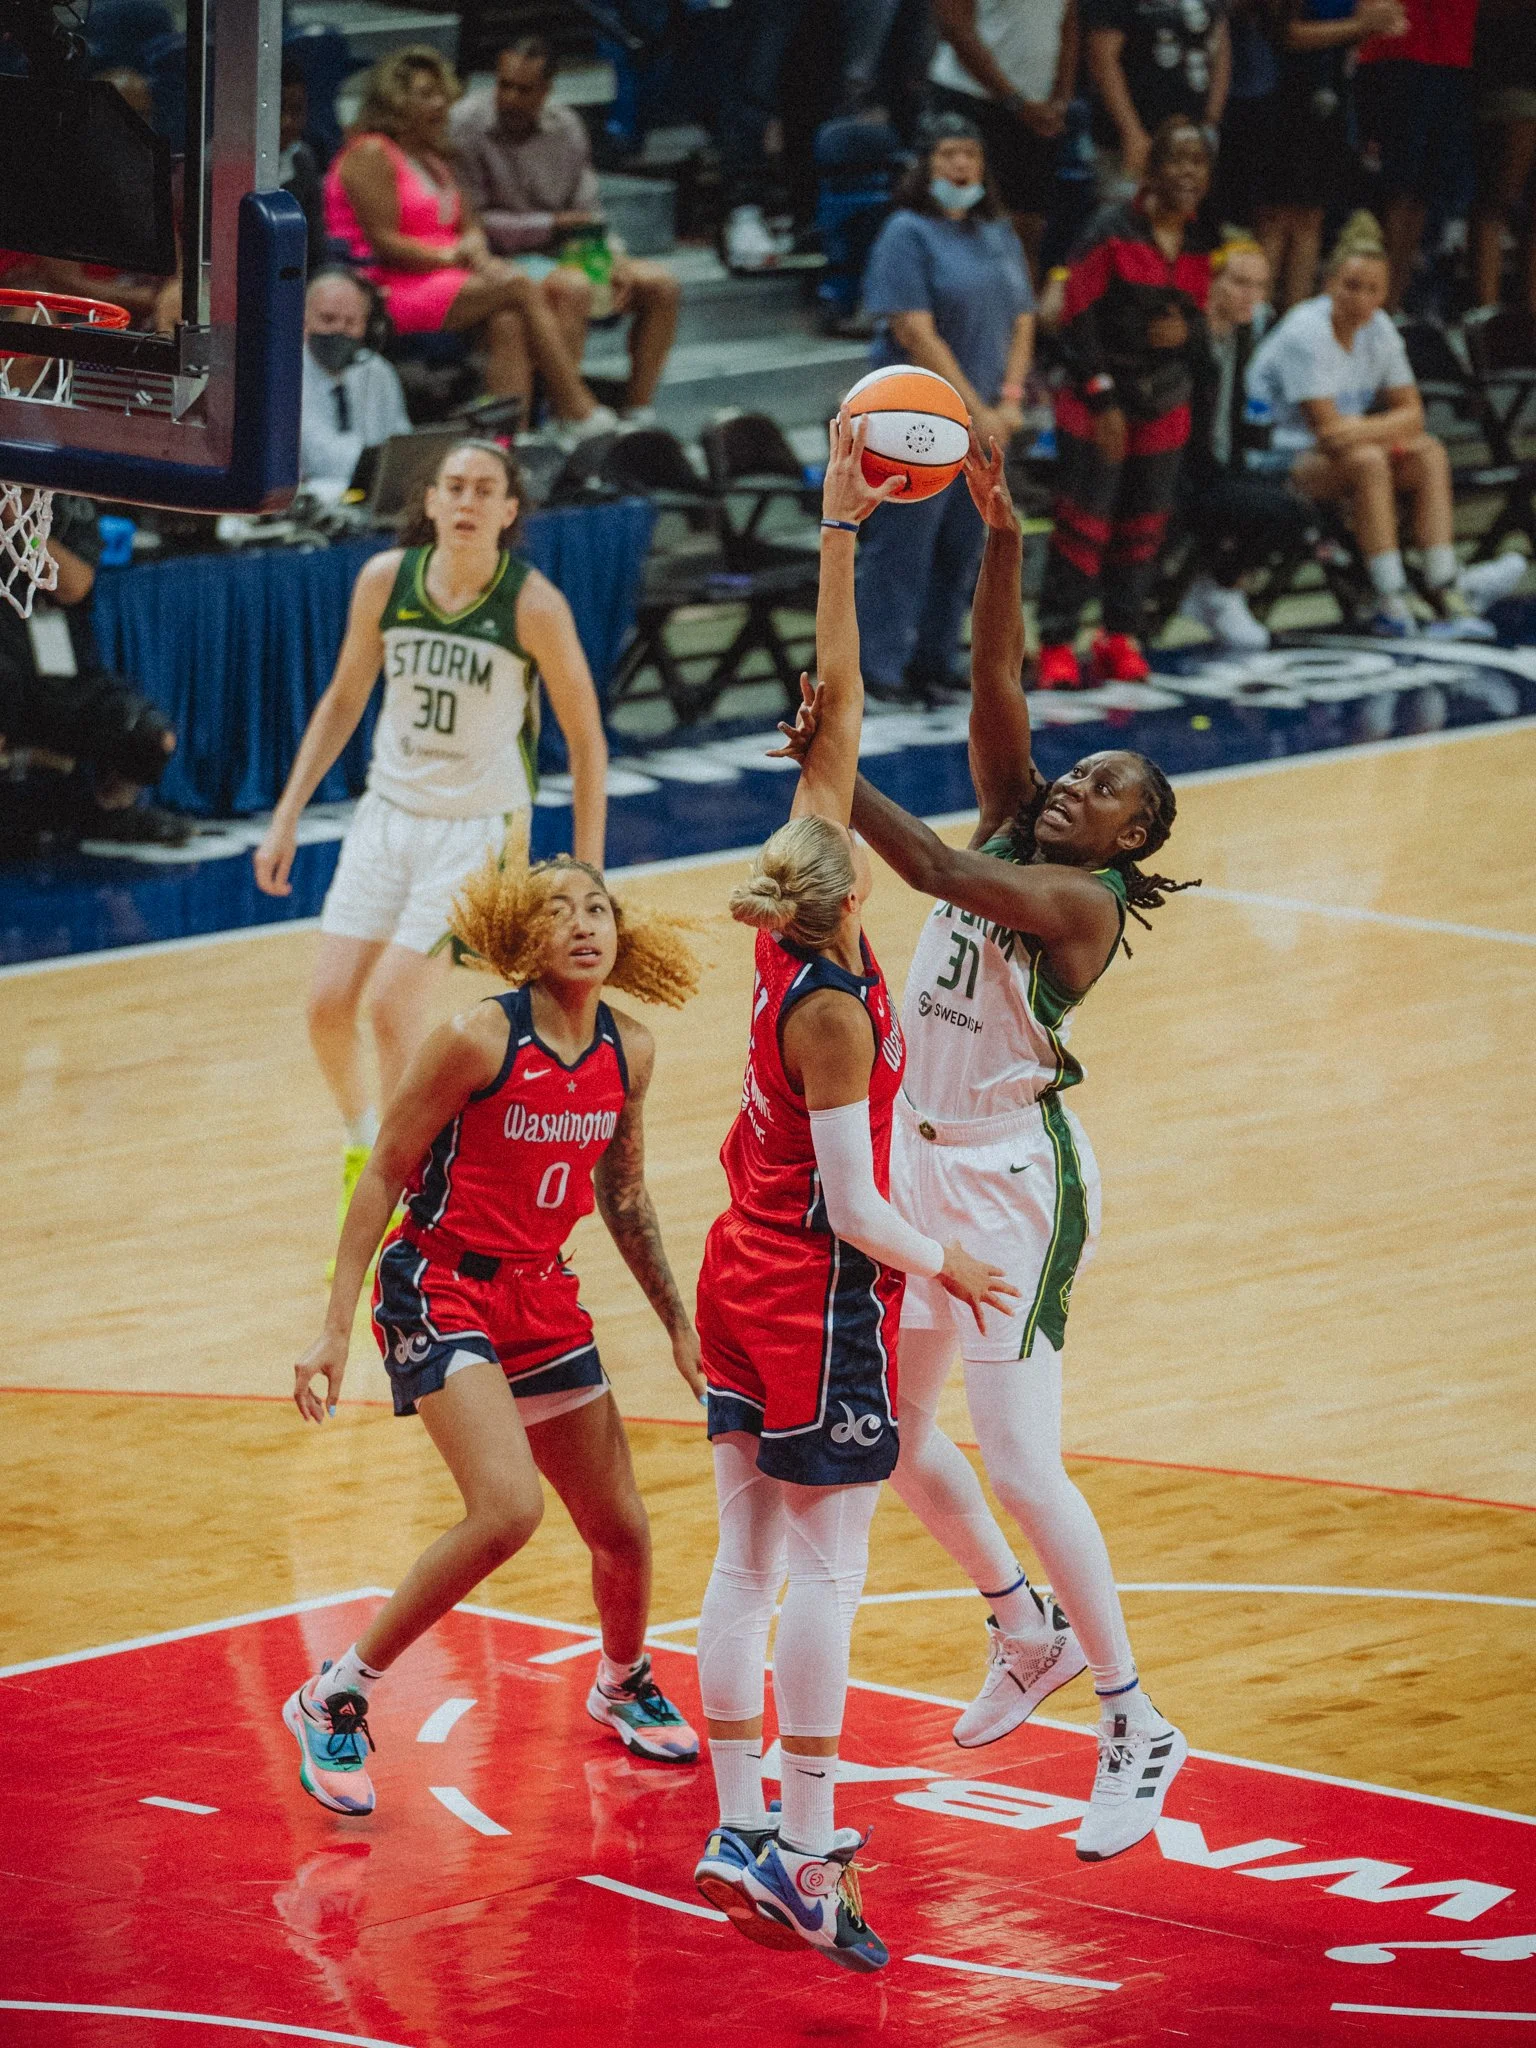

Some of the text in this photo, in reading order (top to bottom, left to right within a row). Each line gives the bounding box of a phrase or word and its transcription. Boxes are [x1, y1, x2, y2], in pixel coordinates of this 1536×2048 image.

[393, 639, 493, 694] STORM
[413, 684, 457, 735] 30
[937, 930, 980, 1000] 31
[933, 1003, 984, 1034] SWEDISH
[503, 1103, 617, 1150] Washington
[536, 1161, 571, 1209] 0
